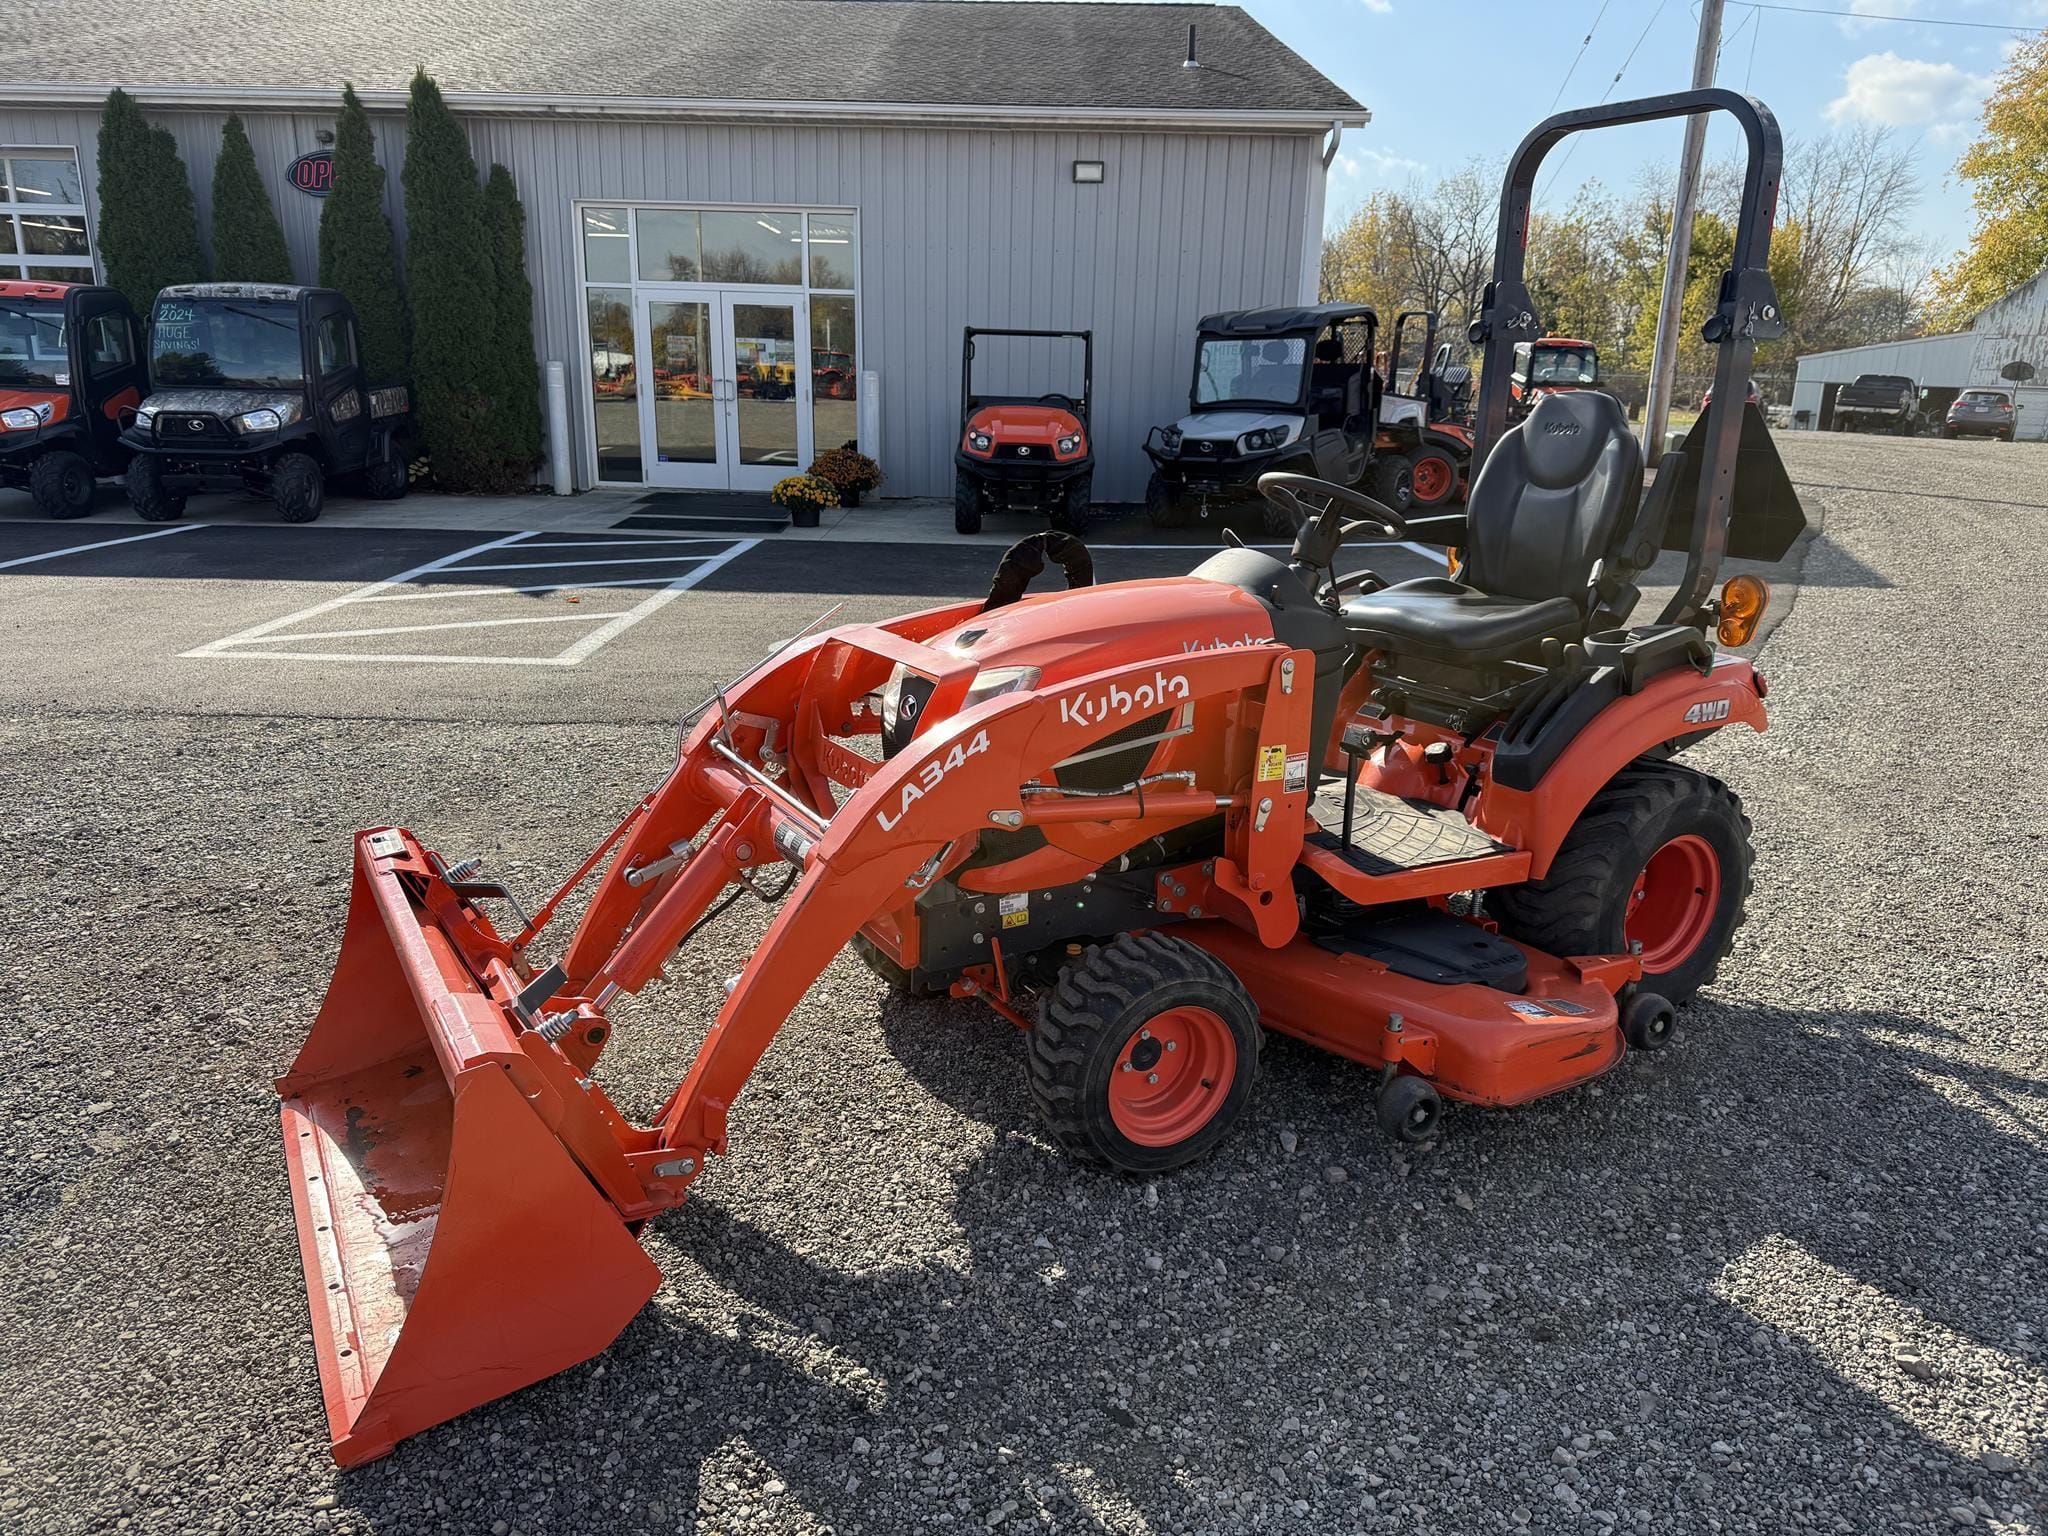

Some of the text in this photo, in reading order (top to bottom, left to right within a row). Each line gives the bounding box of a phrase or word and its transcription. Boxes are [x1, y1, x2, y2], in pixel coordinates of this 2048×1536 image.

[297, 160, 341, 189] OP
[159, 308, 194, 321] 2024
[158, 325, 193, 339] HUGE
[1543, 422, 1581, 435] Kubota
[1060, 671, 1190, 727] Kubota
[1683, 699, 1730, 724] 4WD
[876, 729, 990, 832] LA344
